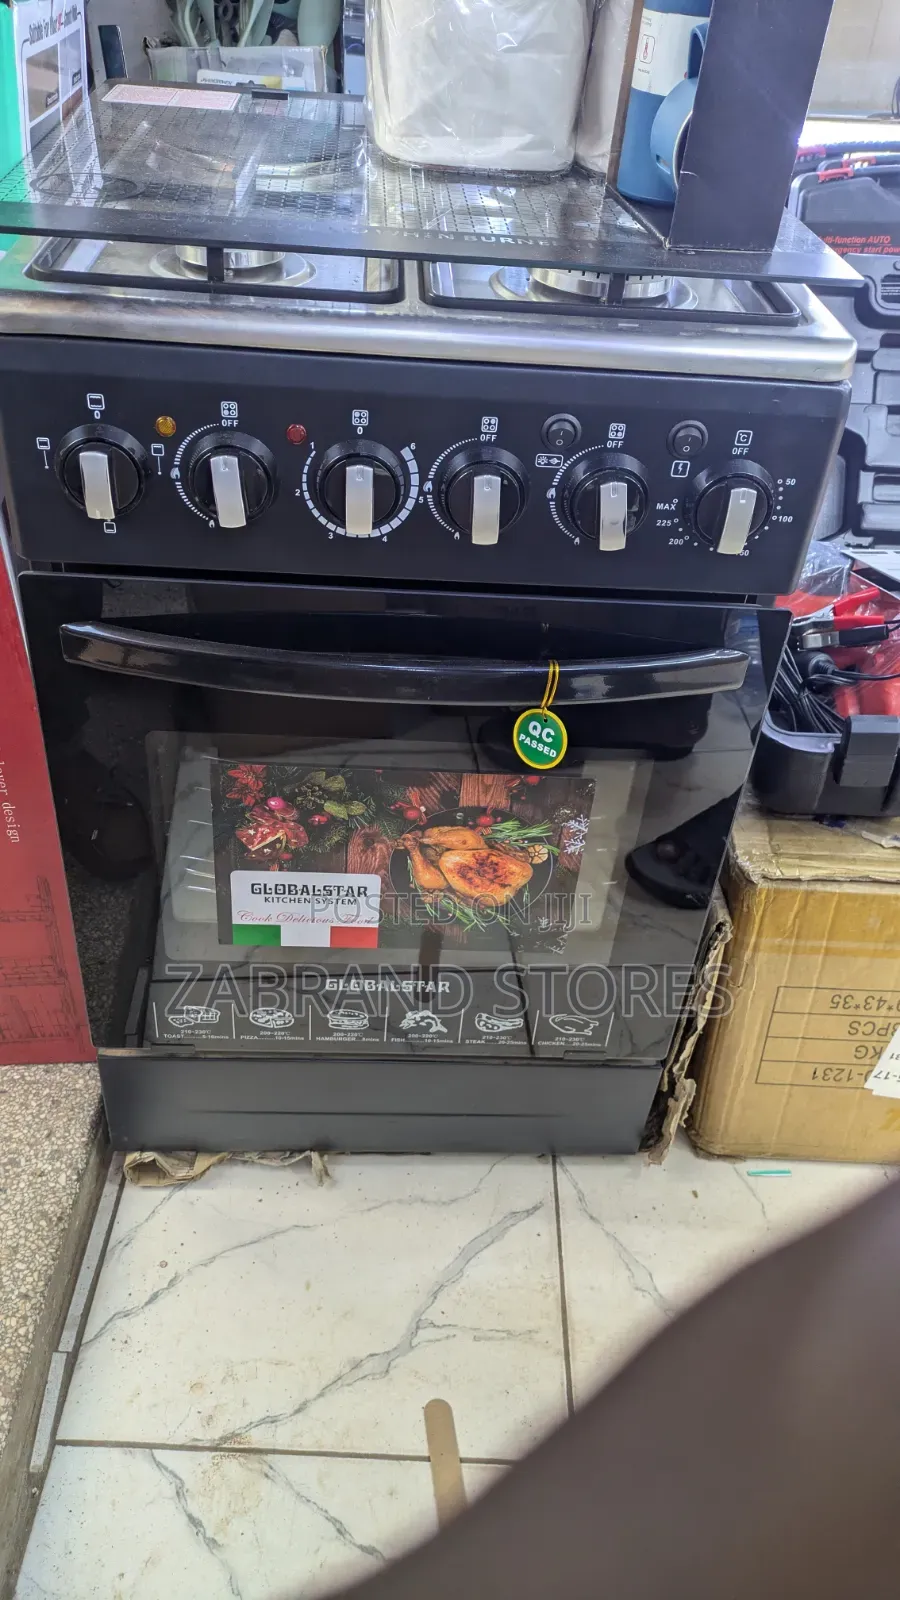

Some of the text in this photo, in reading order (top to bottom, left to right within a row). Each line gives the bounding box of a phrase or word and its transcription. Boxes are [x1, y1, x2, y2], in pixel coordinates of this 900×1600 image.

[867, 235, 891, 244] AUTO
[221, 419, 239, 428] OFF
[480, 434, 498, 442] OFF
[310, 441, 315, 450] 1
[410, 442, 416, 450] 6
[606, 440, 624, 449] OFF
[731, 447, 750, 456] OFF
[785, 478, 796, 486] 50
[295, 488, 301, 497] 2
[418, 496, 424, 504] 5
[656, 502, 676, 511] MAX
[656, 519, 671, 527] 225
[778, 515, 793, 523] 100
[328, 532, 334, 540] 3
[381, 535, 388, 543] 4
[668, 538, 684, 546] 200
[528, 720, 555, 743] QC
[518, 733, 557, 758] PASSED
[1, 802, 21, 843] design
[251, 883, 368, 898] GLOBALSTAR
[264, 896, 357, 906] KITCHEN SYSTEM
[237, 910, 273, 923] Cook
[325, 978, 451, 993] GLOBALSTAR
